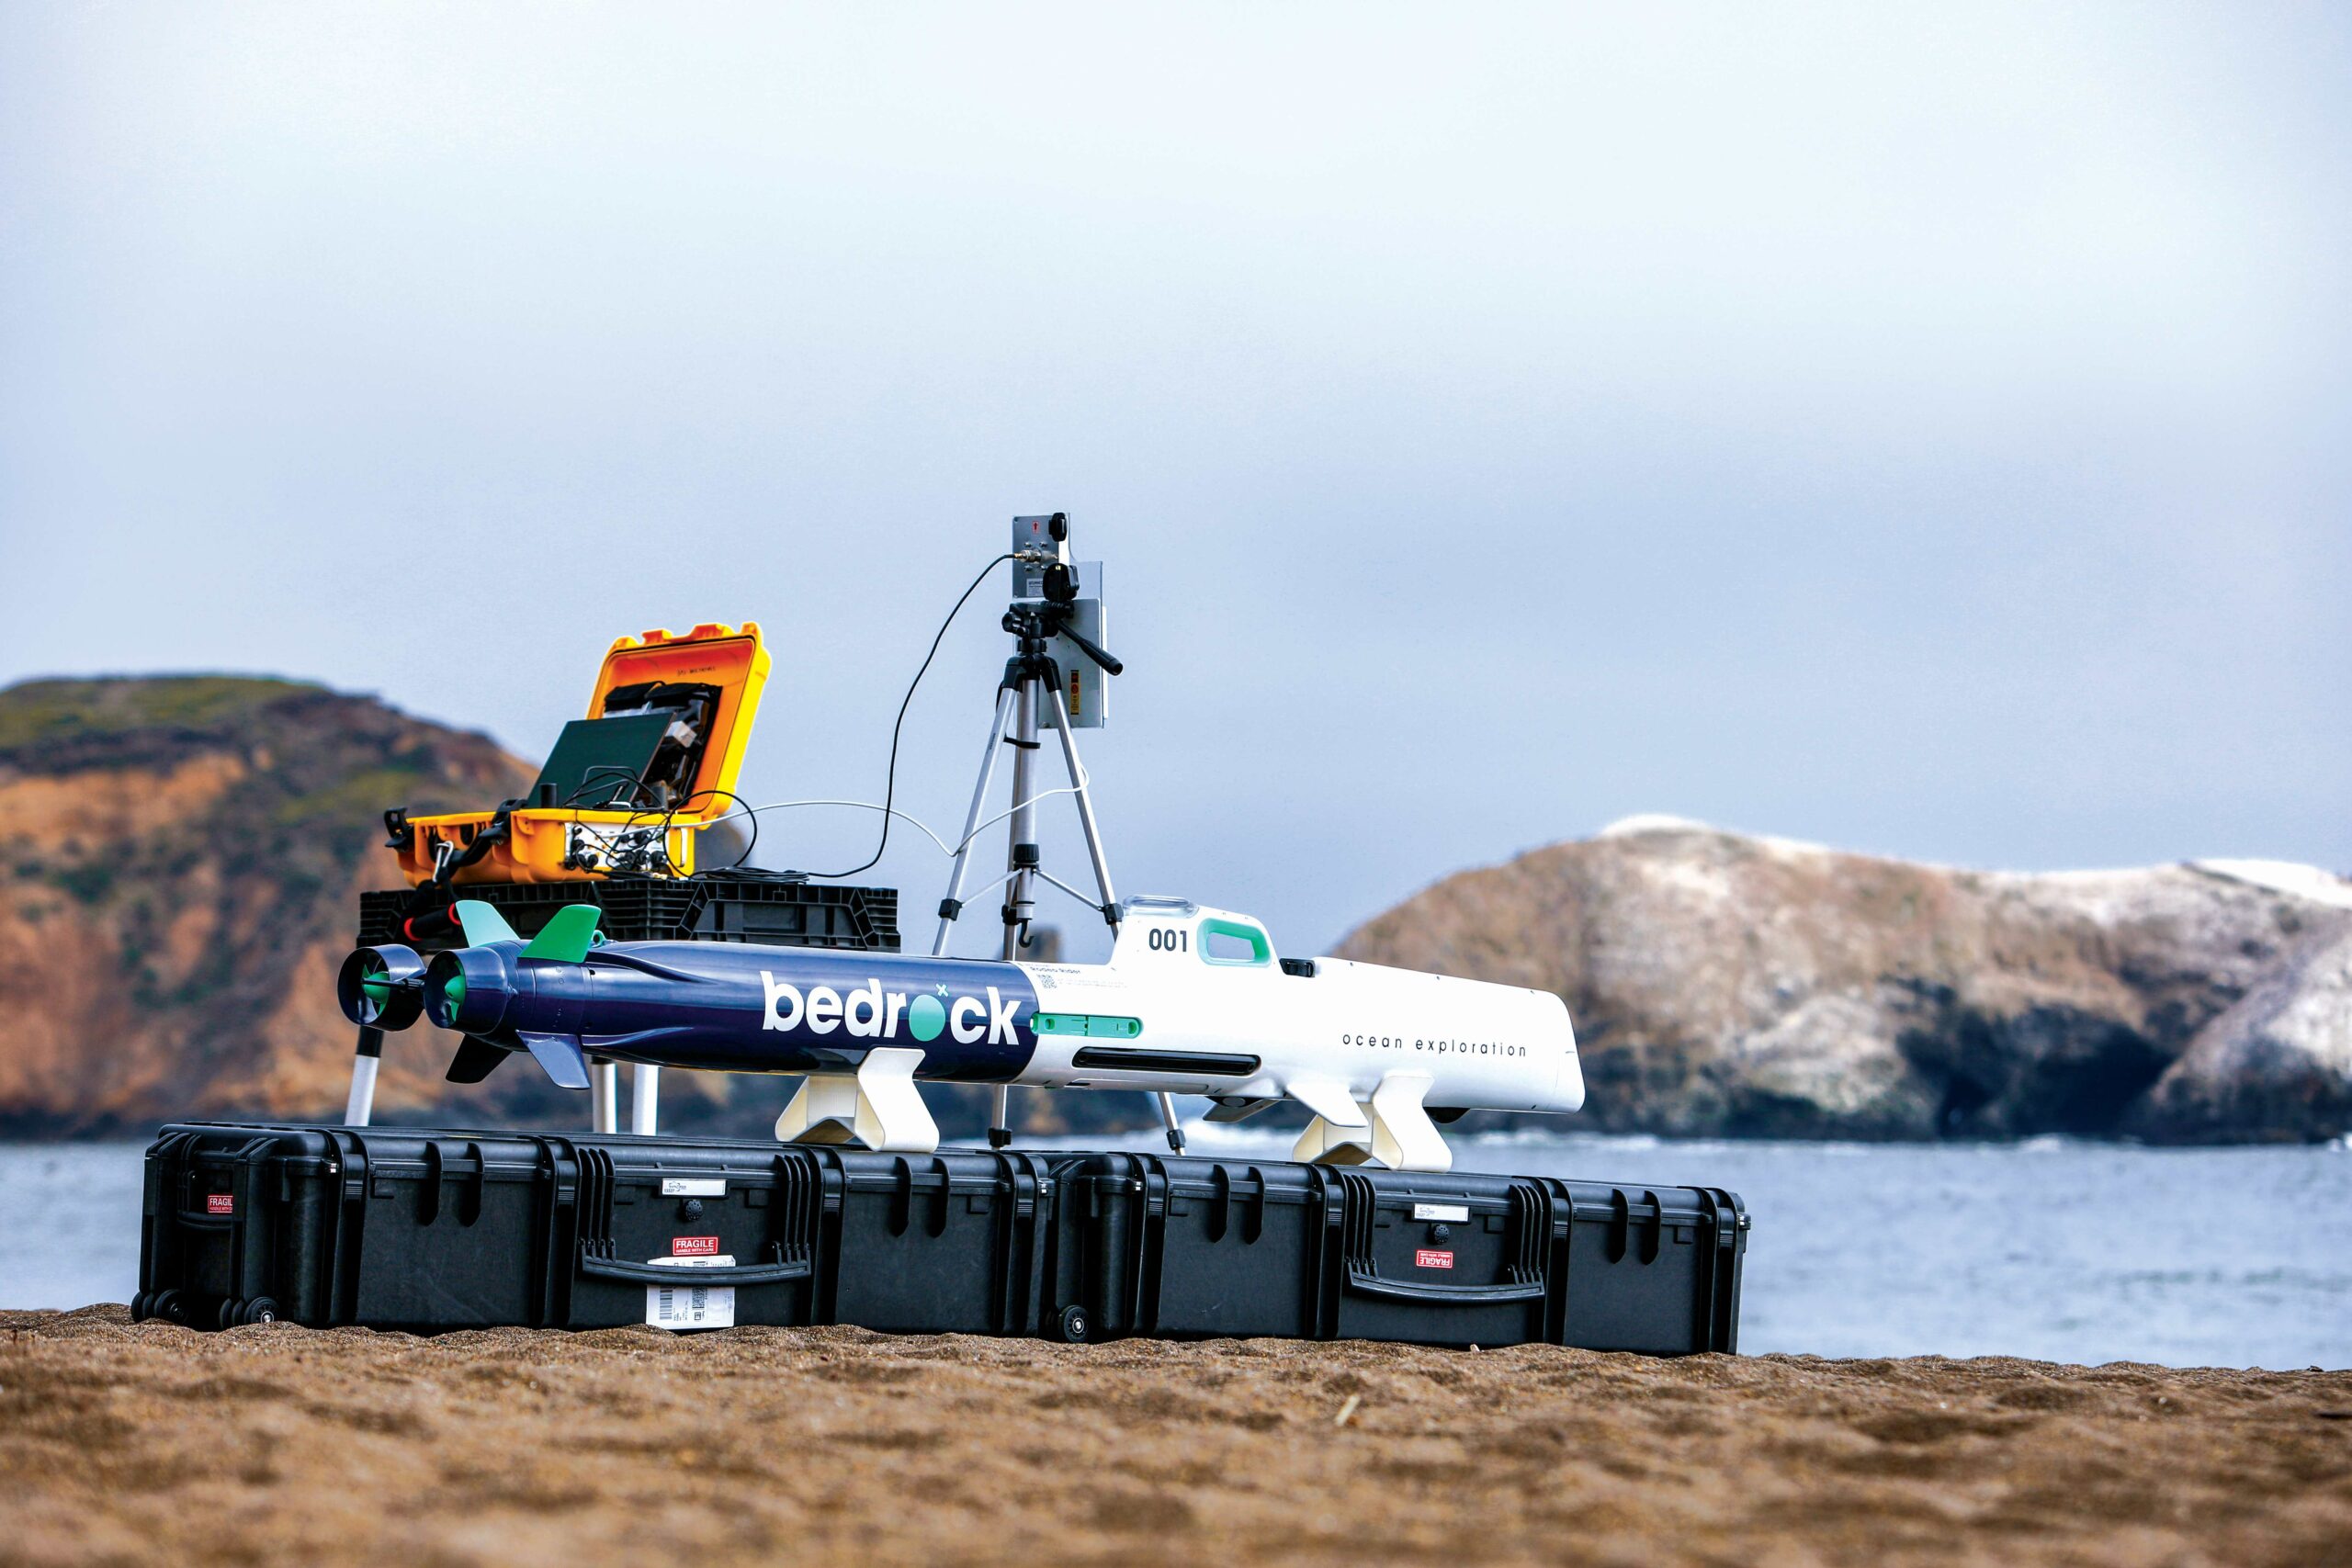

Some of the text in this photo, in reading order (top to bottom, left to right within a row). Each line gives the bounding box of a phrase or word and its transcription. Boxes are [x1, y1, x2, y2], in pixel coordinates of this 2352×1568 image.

[1148, 928, 1187, 953] 001
[759, 970, 1022, 1045] bedrock
[1342, 1033, 1526, 1057] ocean exploration
[209, 1198, 232, 1206] FRAGIL
[675, 1239, 715, 1249] FRAGILE
[1419, 1258, 1451, 1266] FRAGILE
